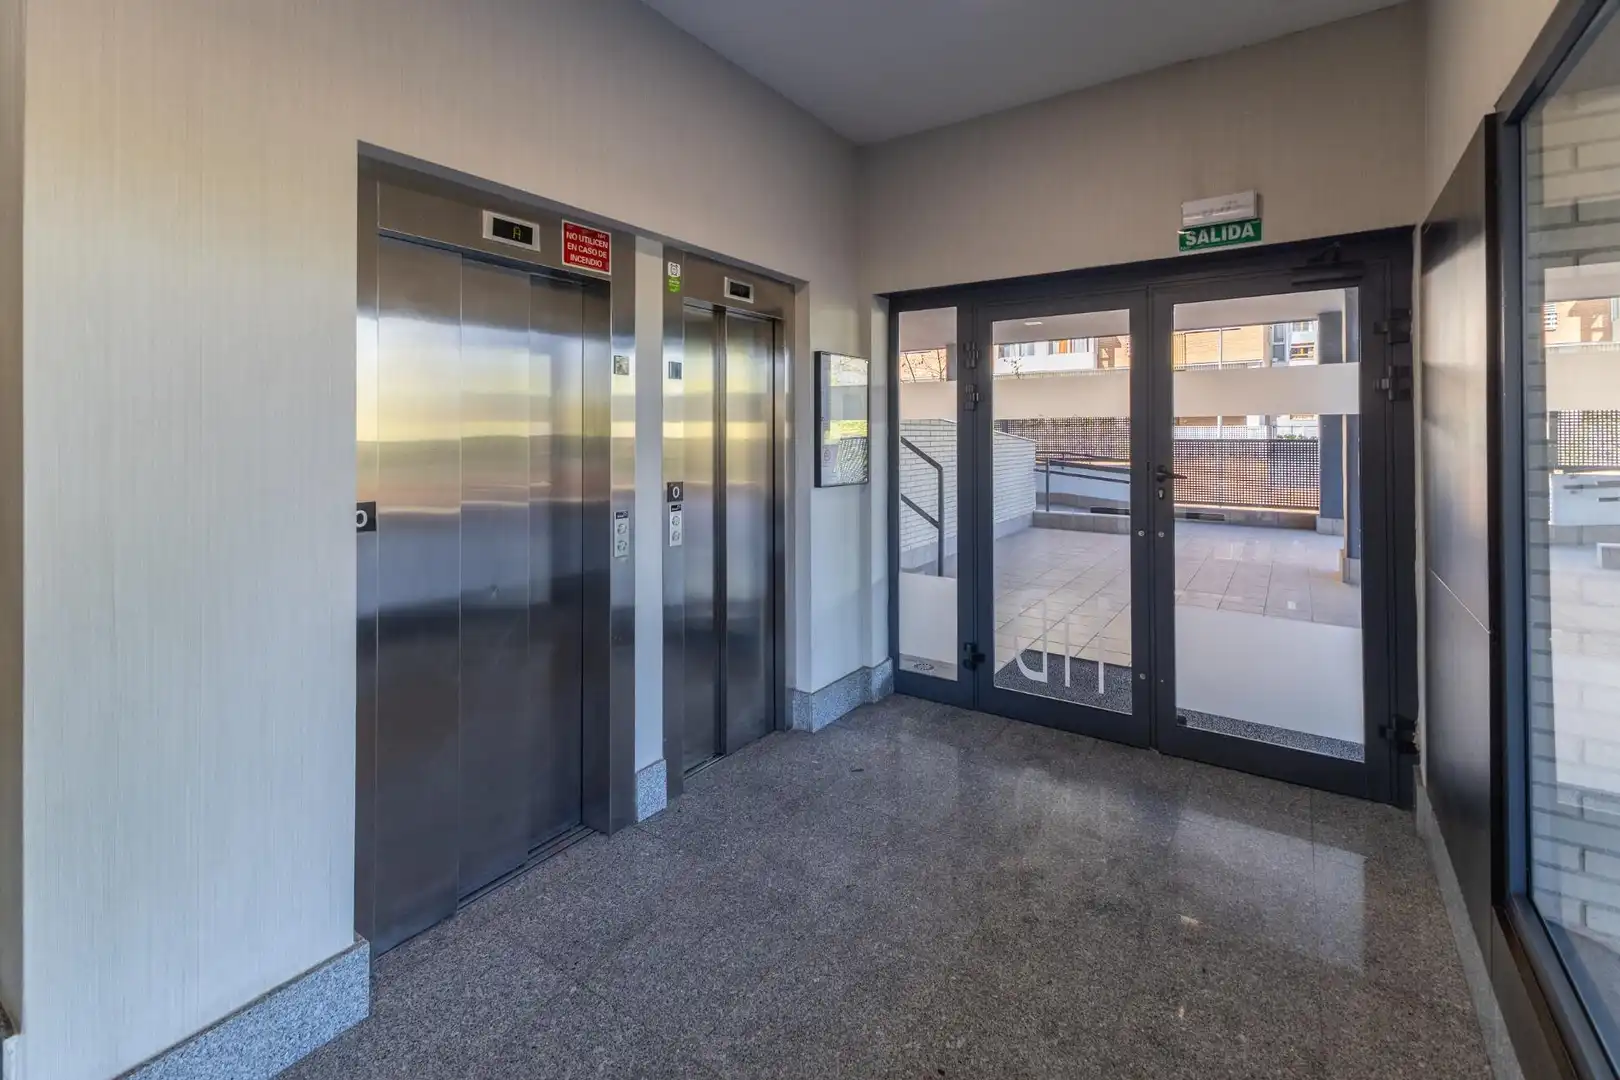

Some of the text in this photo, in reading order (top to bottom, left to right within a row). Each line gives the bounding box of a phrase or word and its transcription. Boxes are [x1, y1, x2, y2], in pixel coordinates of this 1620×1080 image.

[566, 231, 578, 241] NO
[578, 234, 608, 249] UTILICEN
[1185, 222, 1255, 246] SALIDA
[567, 242, 607, 259] EN CASO DE
[570, 253, 603, 268] INCENDIO
